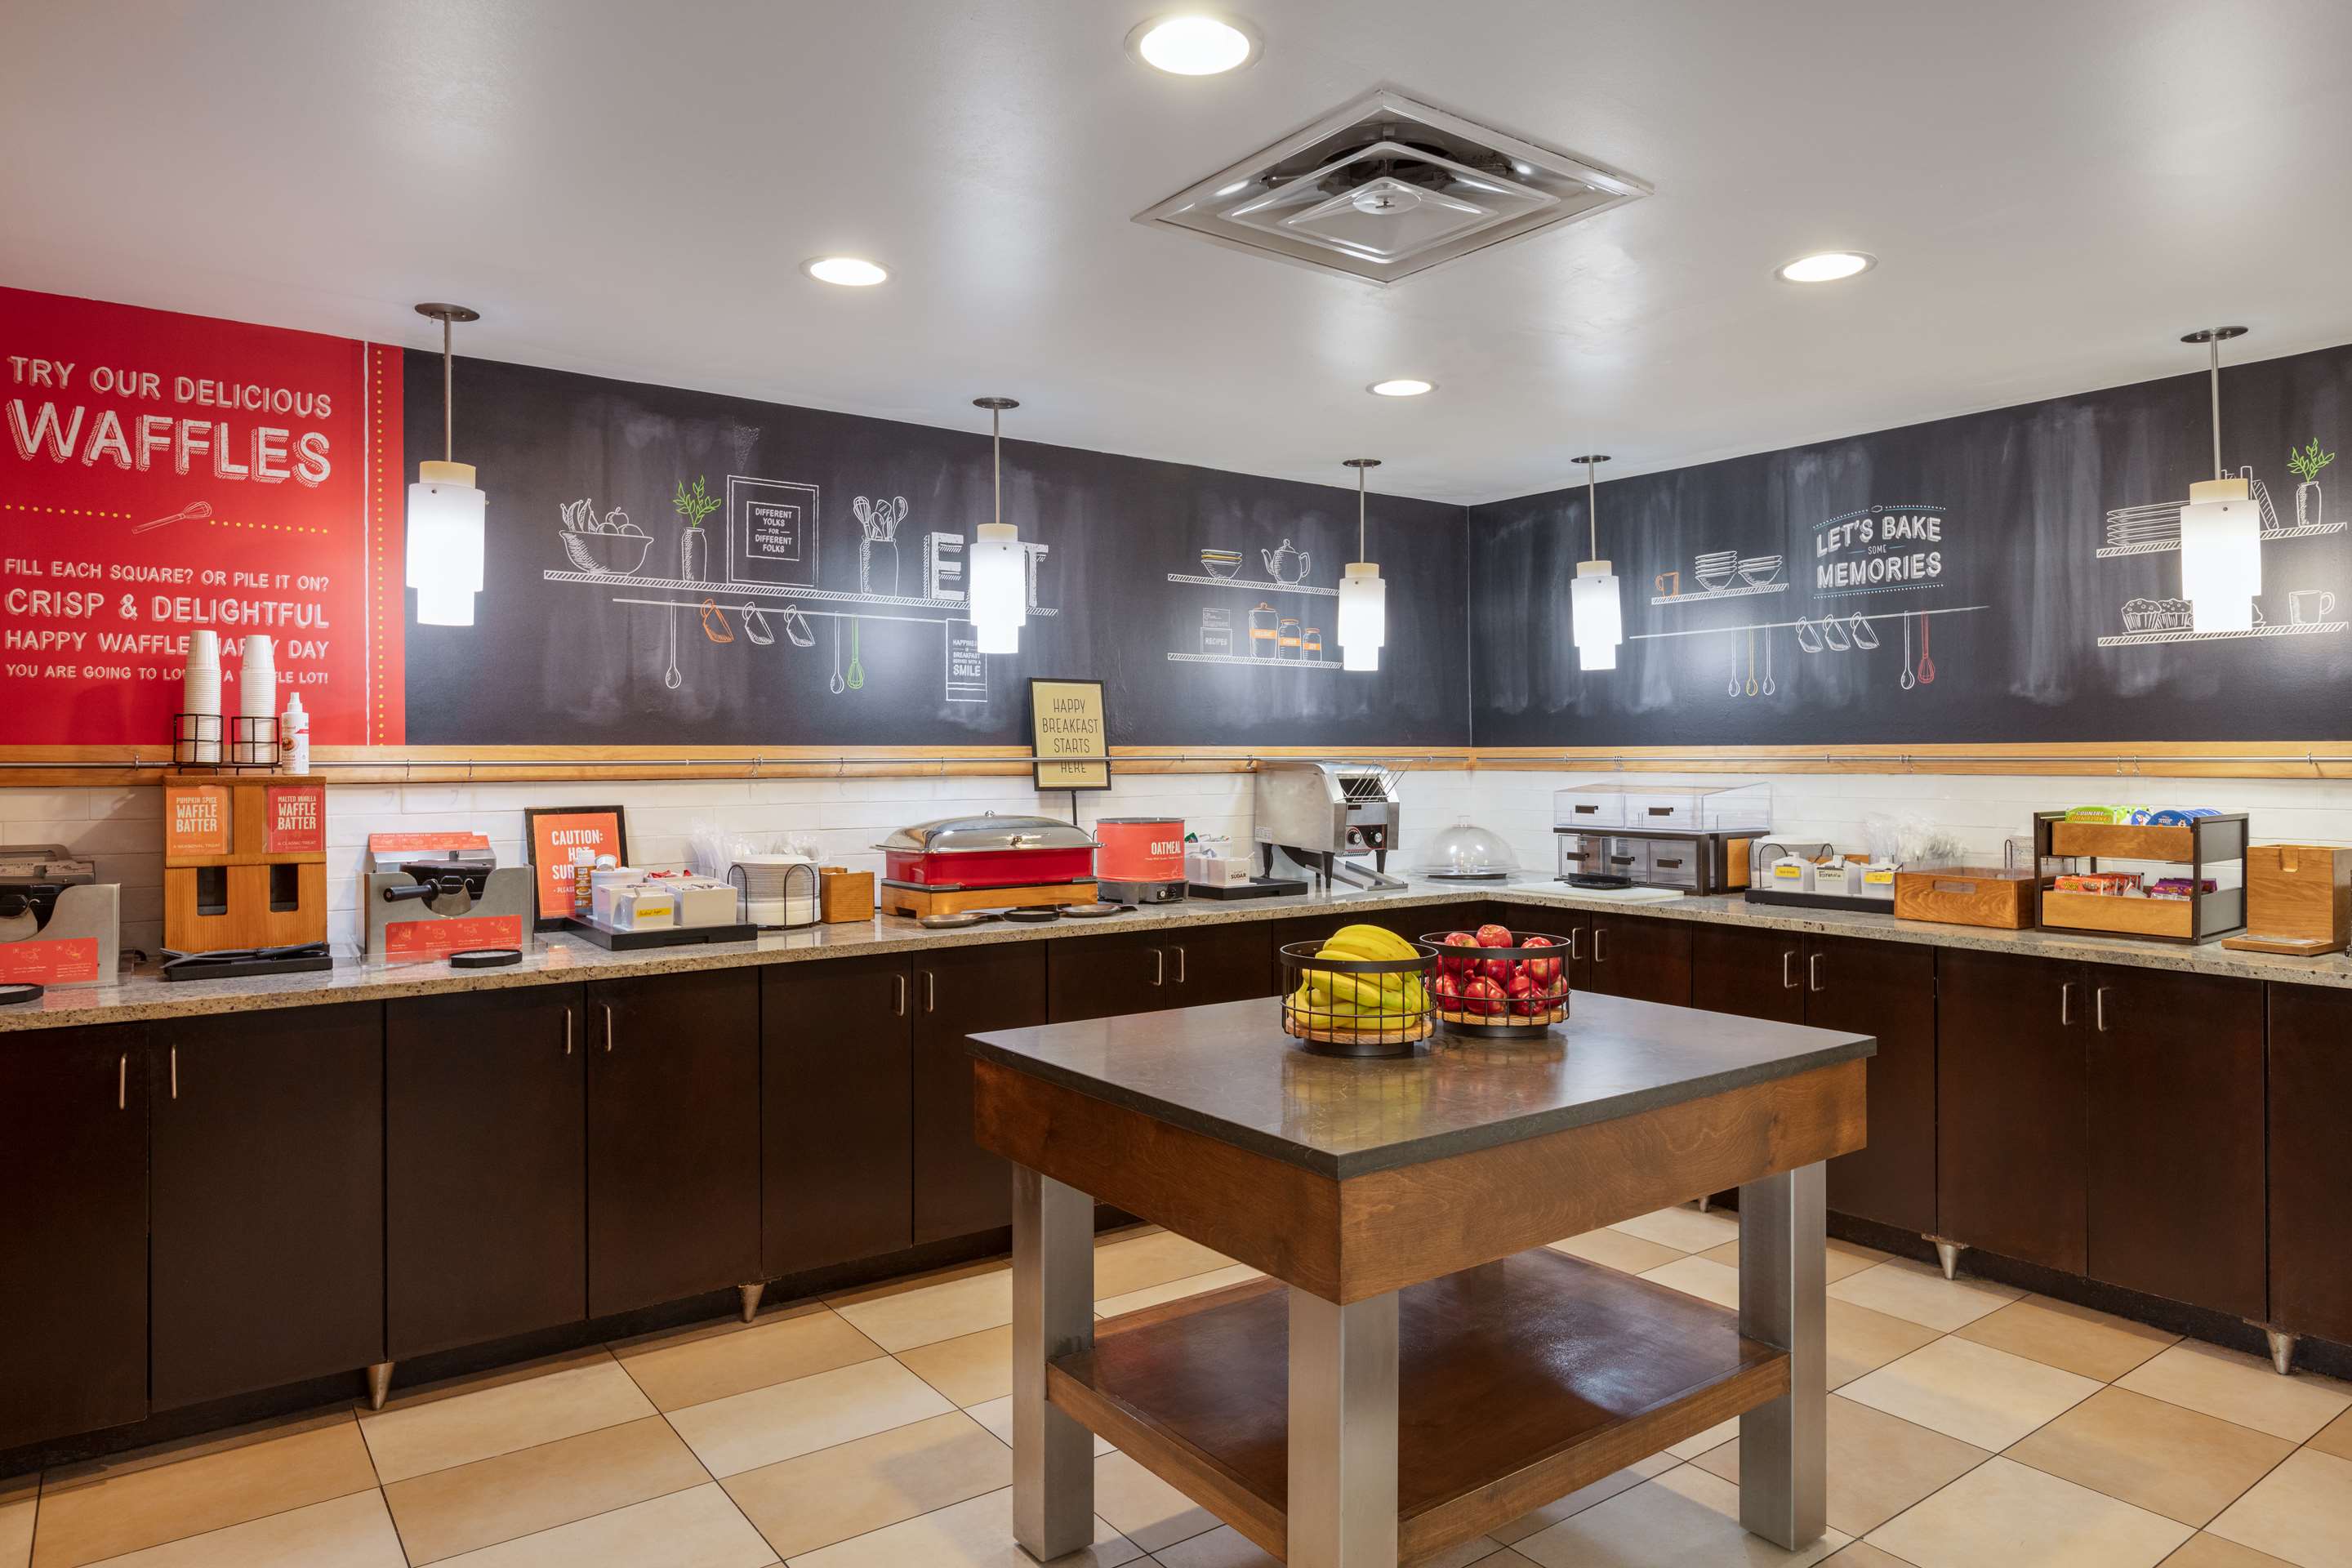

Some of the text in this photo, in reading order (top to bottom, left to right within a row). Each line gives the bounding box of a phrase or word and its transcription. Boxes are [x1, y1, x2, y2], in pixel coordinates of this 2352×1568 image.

[8, 356, 332, 420] TRY OUR DELICIOUS
[7, 399, 332, 488] WAFFLES
[755, 508, 792, 519] DIFFERENT
[763, 517, 785, 527] YOLKS
[755, 534, 792, 545] DIFFERENT
[1816, 515, 1942, 558] LET'S BAKE
[763, 544, 785, 553] FOLKS
[1868, 544, 1887, 555] SOME
[5, 559, 330, 592] FILL EACH SQUARE? OR PILE IT ON?
[923, 532, 1049, 608] ET
[1816, 551, 1942, 589] MEMORIES
[5, 588, 330, 628] CRISP & DELIGHTFUL
[5, 630, 87, 652] HAPPY
[288, 639, 329, 660] DAY
[6, 663, 38, 677] YOU
[44, 666, 77, 679] ARE
[82, 666, 131, 679] GOING
[137, 667, 158, 680] TO
[223, 670, 234, 683] A
[299, 671, 328, 684] LOT!
[953, 664, 981, 676] SMILE
[1053, 698, 1085, 714] HAPPY
[1042, 718, 1098, 733] BREAKFAST
[1054, 737, 1090, 753] STARTS
[1060, 760, 1087, 773] HERE
[176, 804, 217, 818] WAFFLE
[278, 802, 317, 817] WAFFLE
[176, 818, 217, 833] BATTER
[278, 816, 317, 831] BATTER
[551, 829, 604, 845] CAUTION:
[1151, 840, 1182, 855] OATMEAL
